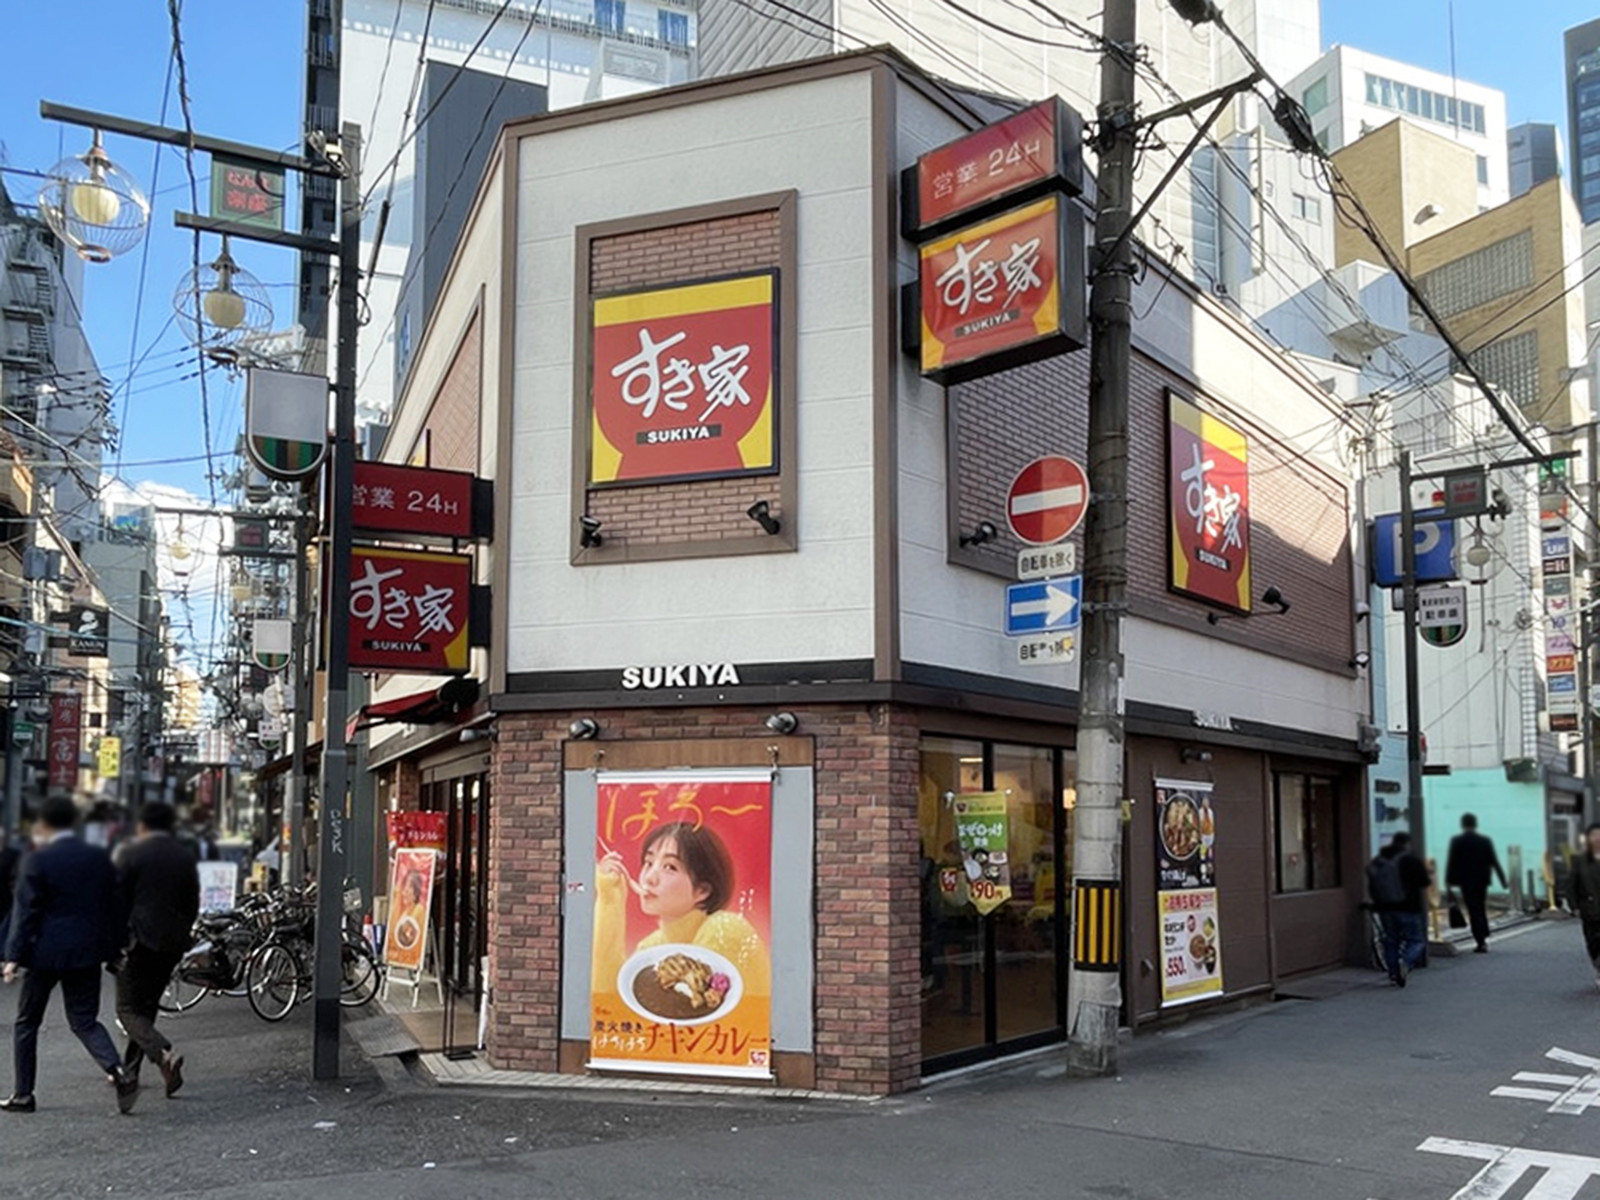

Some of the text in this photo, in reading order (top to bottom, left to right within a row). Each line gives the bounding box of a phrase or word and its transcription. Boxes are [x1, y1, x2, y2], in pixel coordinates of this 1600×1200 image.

[933, 162, 979, 201] 営業
[935, 238, 1042, 315] すき家
[962, 313, 1011, 335] SUKIYA
[610, 328, 751, 422] すき家
[647, 426, 710, 444] SUKIYA
[407, 490, 458, 515] 24H
[1180, 442, 1242, 553] すき家
[1021, 551, 1072, 573] 自転車を除く
[1394, 520, 1441, 576] P
[350, 559, 455, 641] すき家
[371, 640, 422, 652] SUKIYA
[621, 662, 740, 689] SUKIYA
[645, 1022, 767, 1056] チキンカレー
